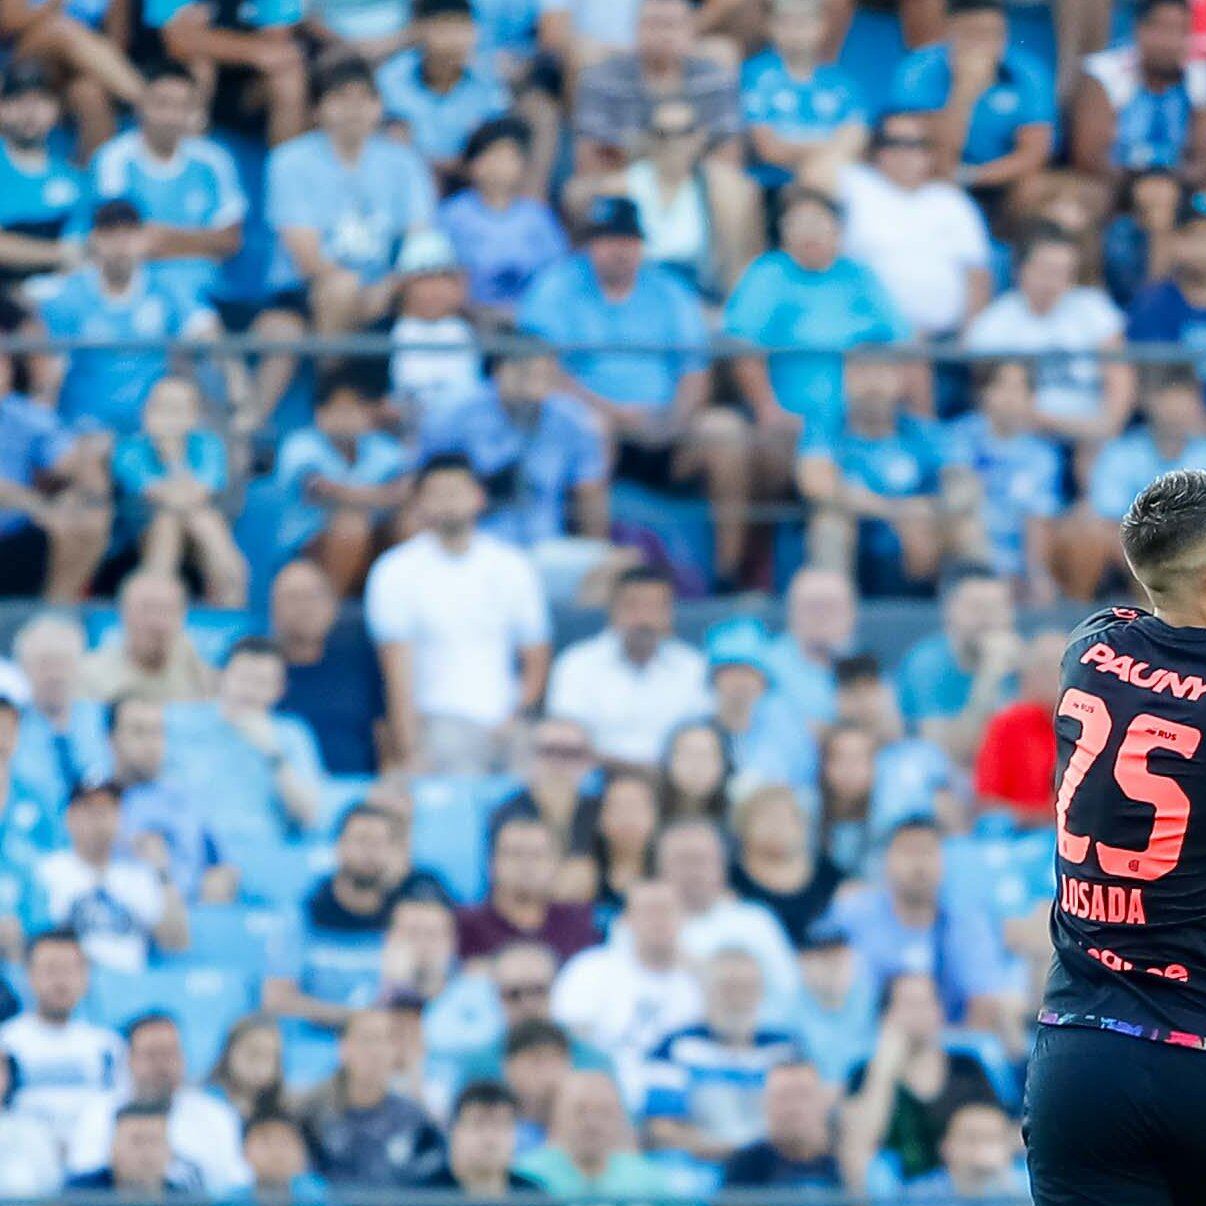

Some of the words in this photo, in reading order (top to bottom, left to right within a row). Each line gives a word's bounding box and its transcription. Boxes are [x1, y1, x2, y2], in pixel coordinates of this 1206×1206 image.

[1157, 729, 1177, 741] RUS
[1056, 687, 1201, 881] 25
[1061, 873, 1146, 925] LOSADA
